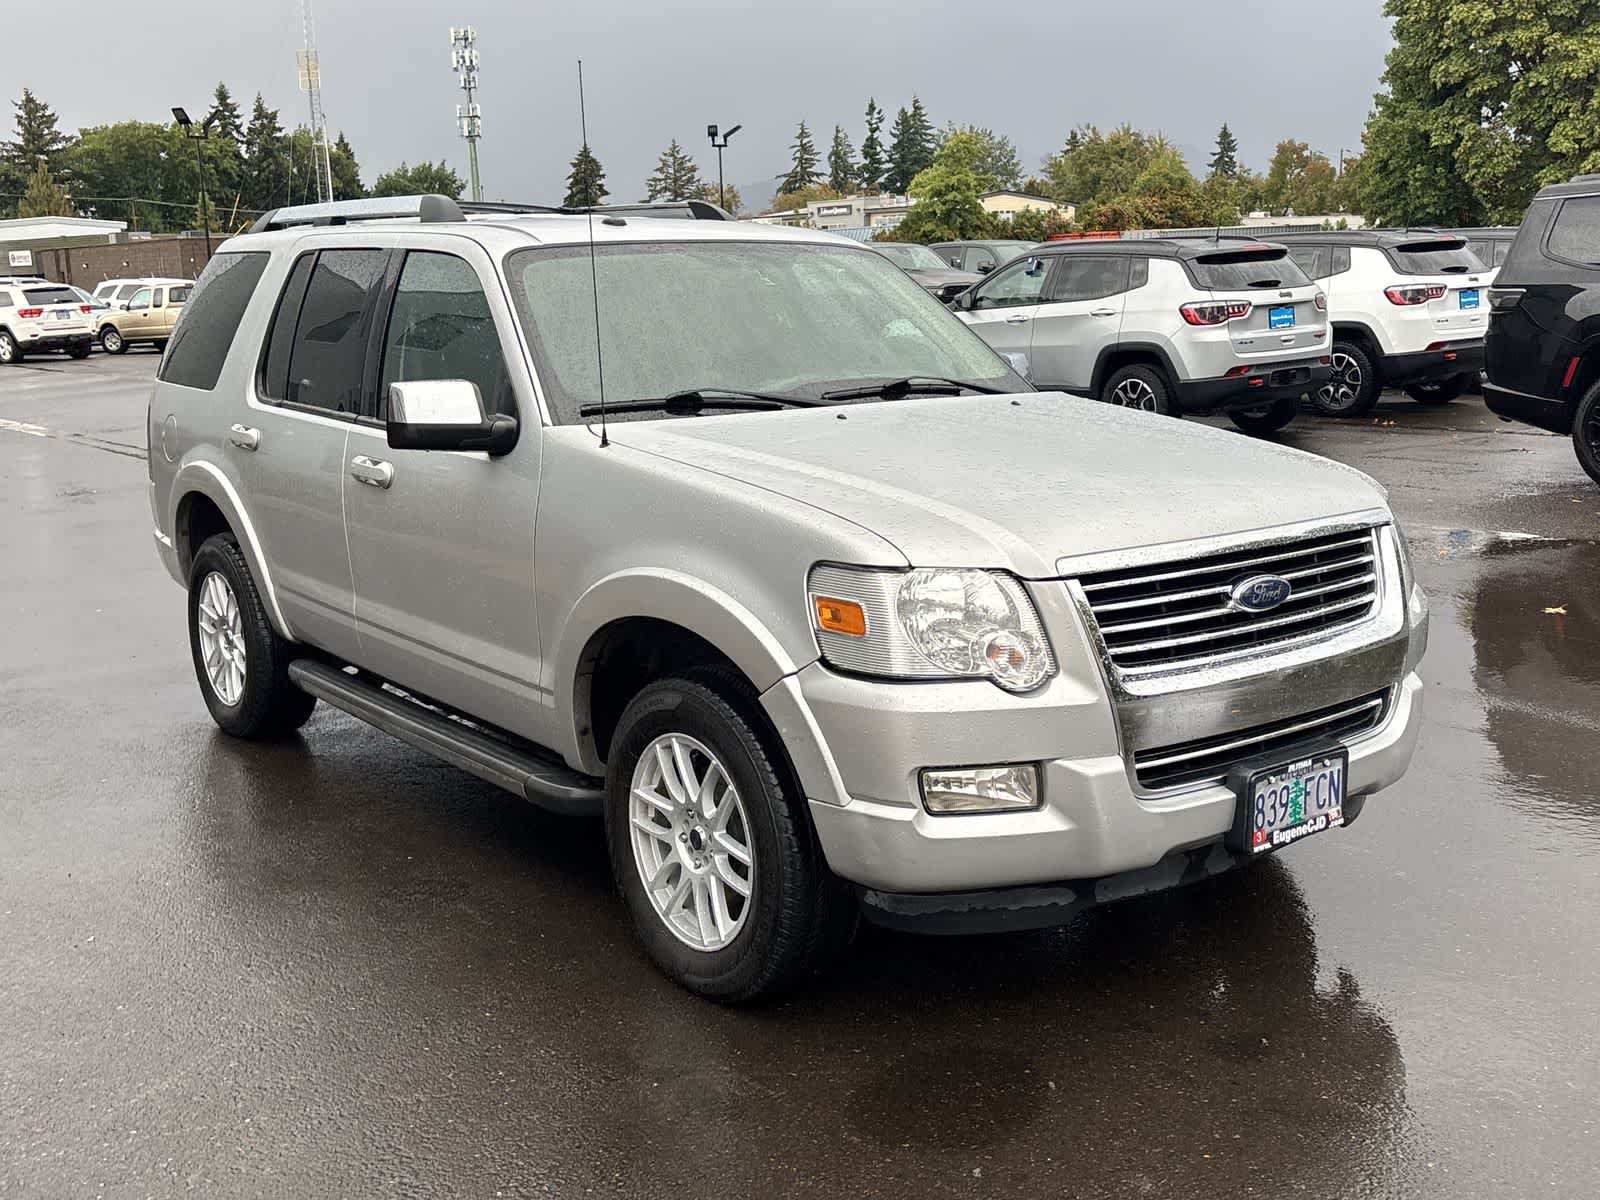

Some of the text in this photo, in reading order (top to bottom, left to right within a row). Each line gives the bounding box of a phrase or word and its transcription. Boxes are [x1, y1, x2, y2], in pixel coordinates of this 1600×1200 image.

[1252, 583, 1282, 604] Ford
[1255, 768, 1342, 829] 839 FCN
[1273, 815, 1326, 845] EugeneCJD
